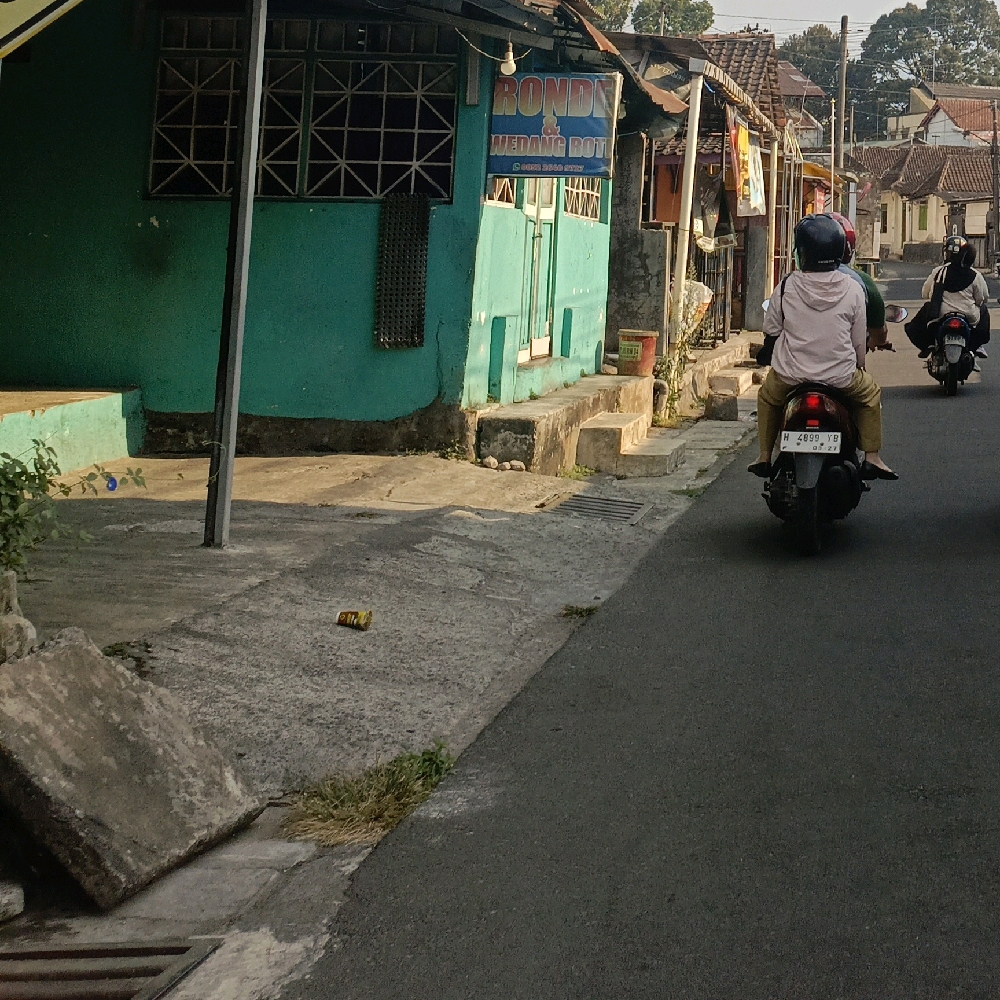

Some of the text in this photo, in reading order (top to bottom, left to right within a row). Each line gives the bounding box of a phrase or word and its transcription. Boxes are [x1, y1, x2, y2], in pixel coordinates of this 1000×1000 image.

[492, 76, 613, 117] RONDE
[542, 115, 560, 136] &
[490, 134, 612, 158] WEDANG ROTI
[783, 433, 789, 442] H
[797, 433, 820, 443] 4899
